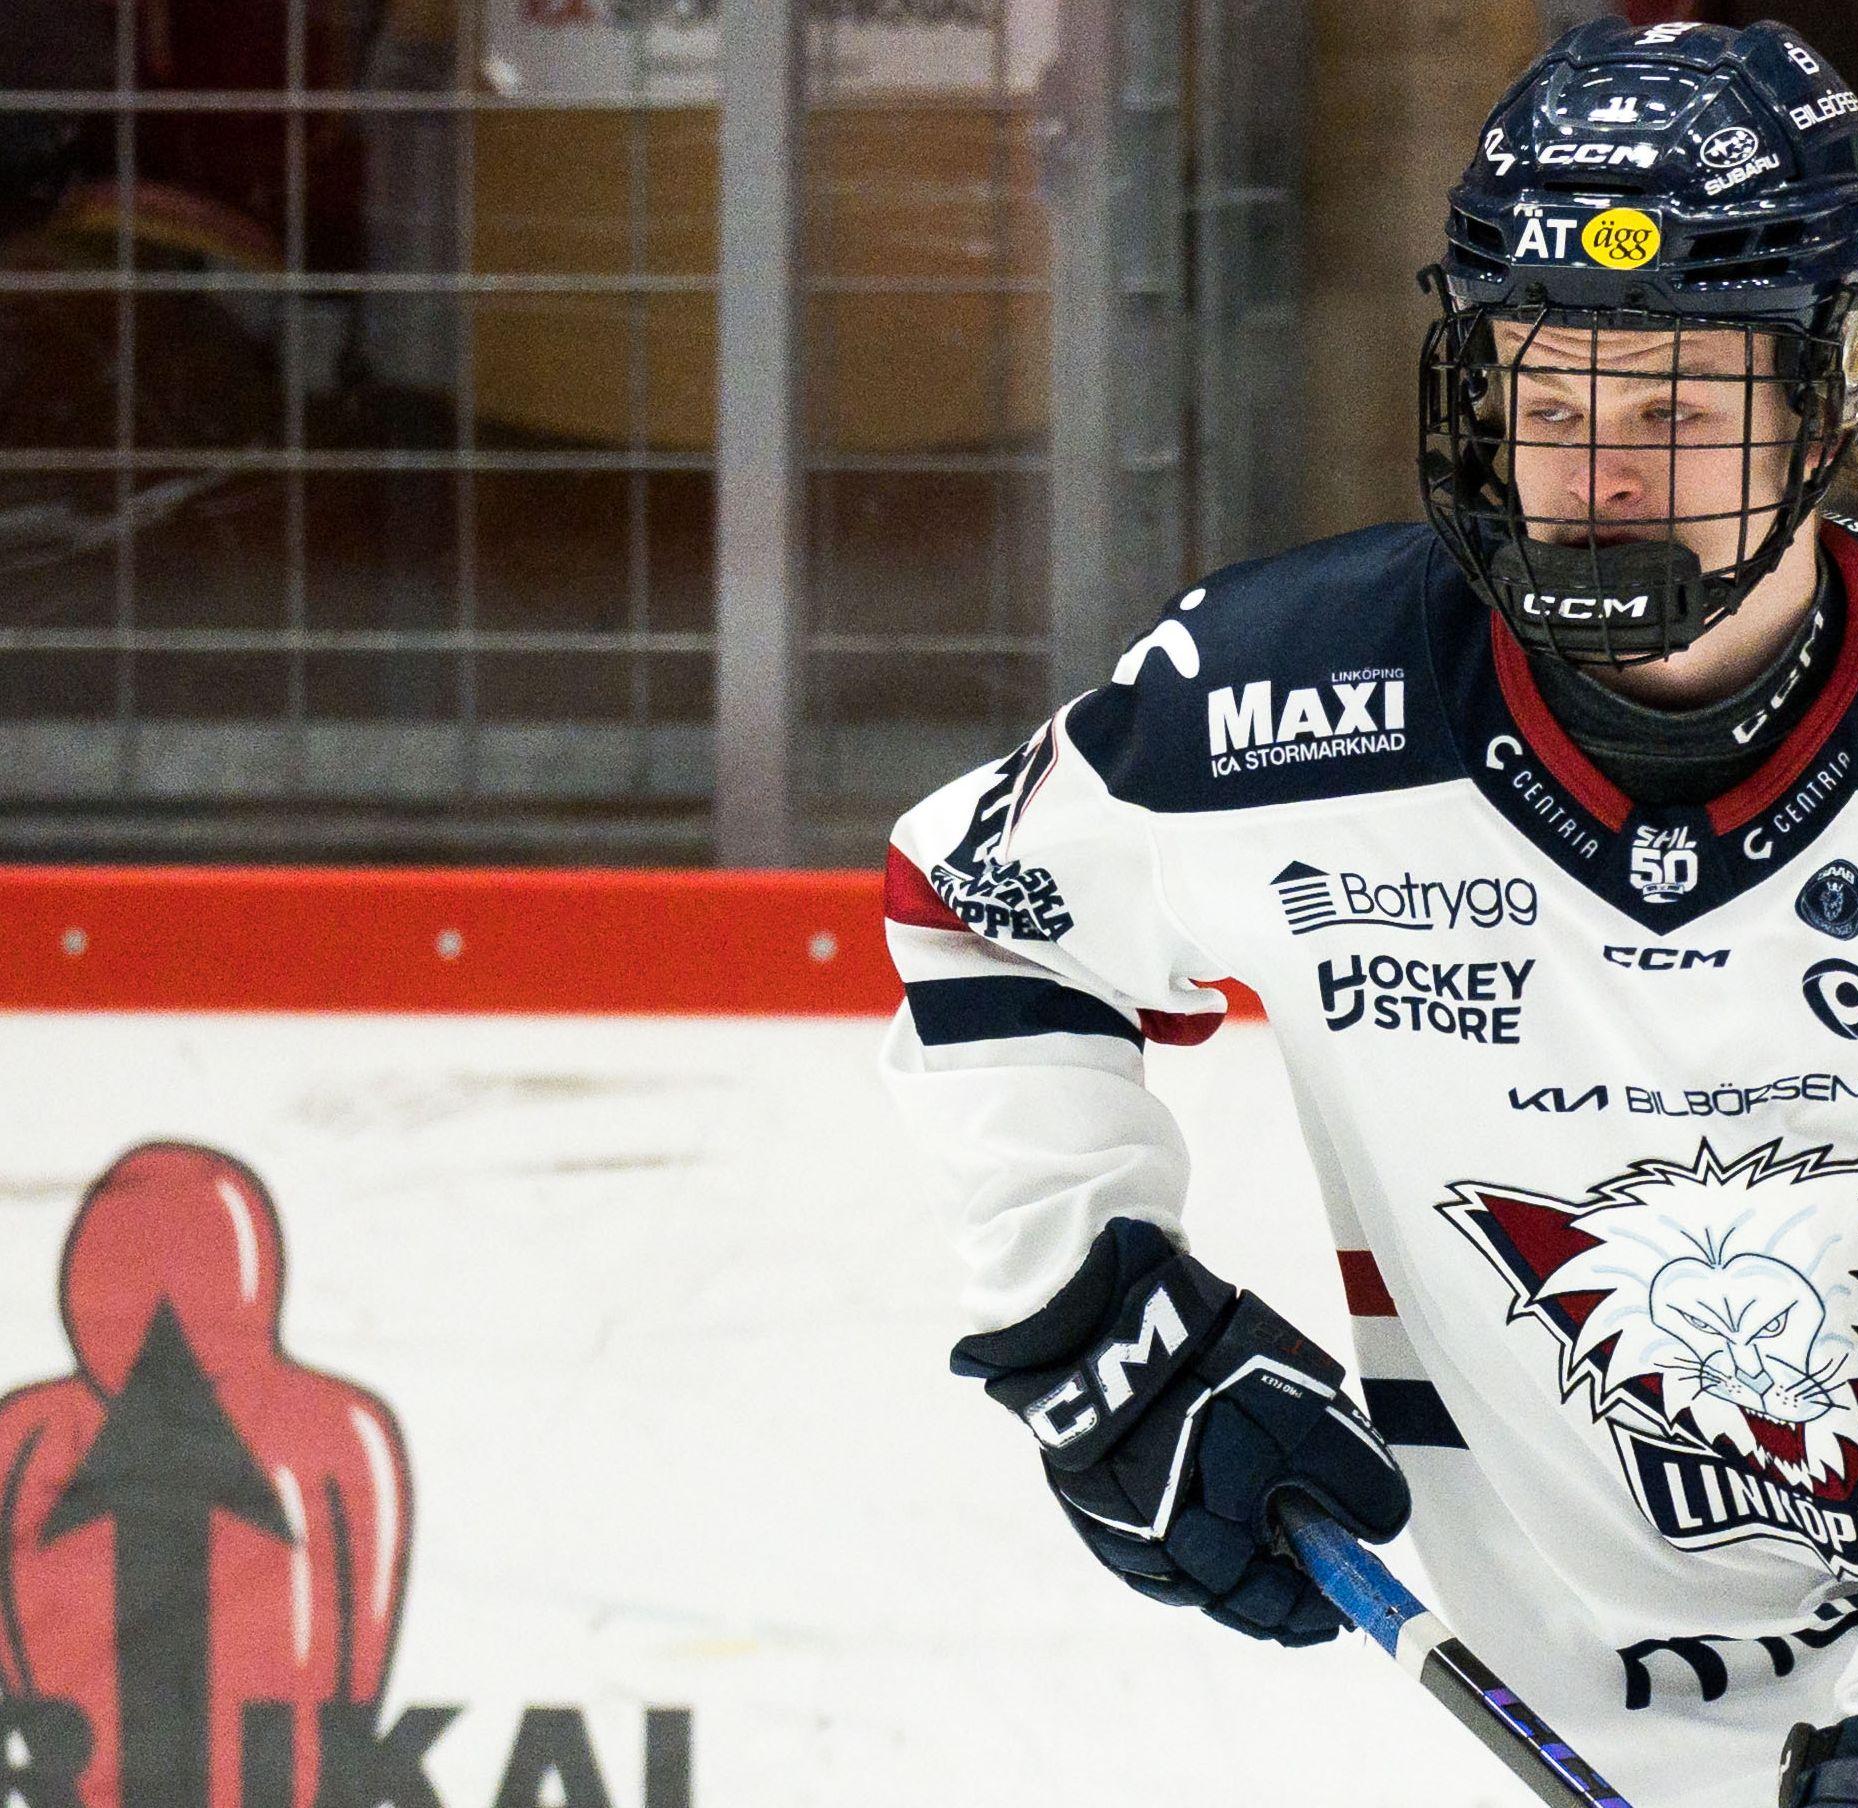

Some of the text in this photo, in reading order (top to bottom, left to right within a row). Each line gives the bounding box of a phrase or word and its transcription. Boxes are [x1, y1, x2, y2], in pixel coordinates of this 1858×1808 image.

[1538, 143, 1660, 169] CCM
[1704, 153, 1781, 196] SUBARU
[1514, 206, 1653, 261] ÄT ägg
[1522, 593, 1649, 619] CCM
[1331, 667, 1405, 684] LINKÖPING
[1731, 610, 1824, 745] CCM
[1207, 680, 1405, 757] MAXI
[1211, 733, 1406, 778] ICA STORMARKNAD
[1512, 770, 1599, 859] CENTRIA
[1773, 751, 1851, 833] CENTRIA
[1632, 825, 1698, 849] SHL
[1630, 847, 1698, 893] 50
[1340, 871, 1538, 929] Botrygg
[1602, 945, 1732, 971] CCM
[1317, 954, 1537, 1012] HOCKEY
[1373, 994, 1523, 1045] STORE
